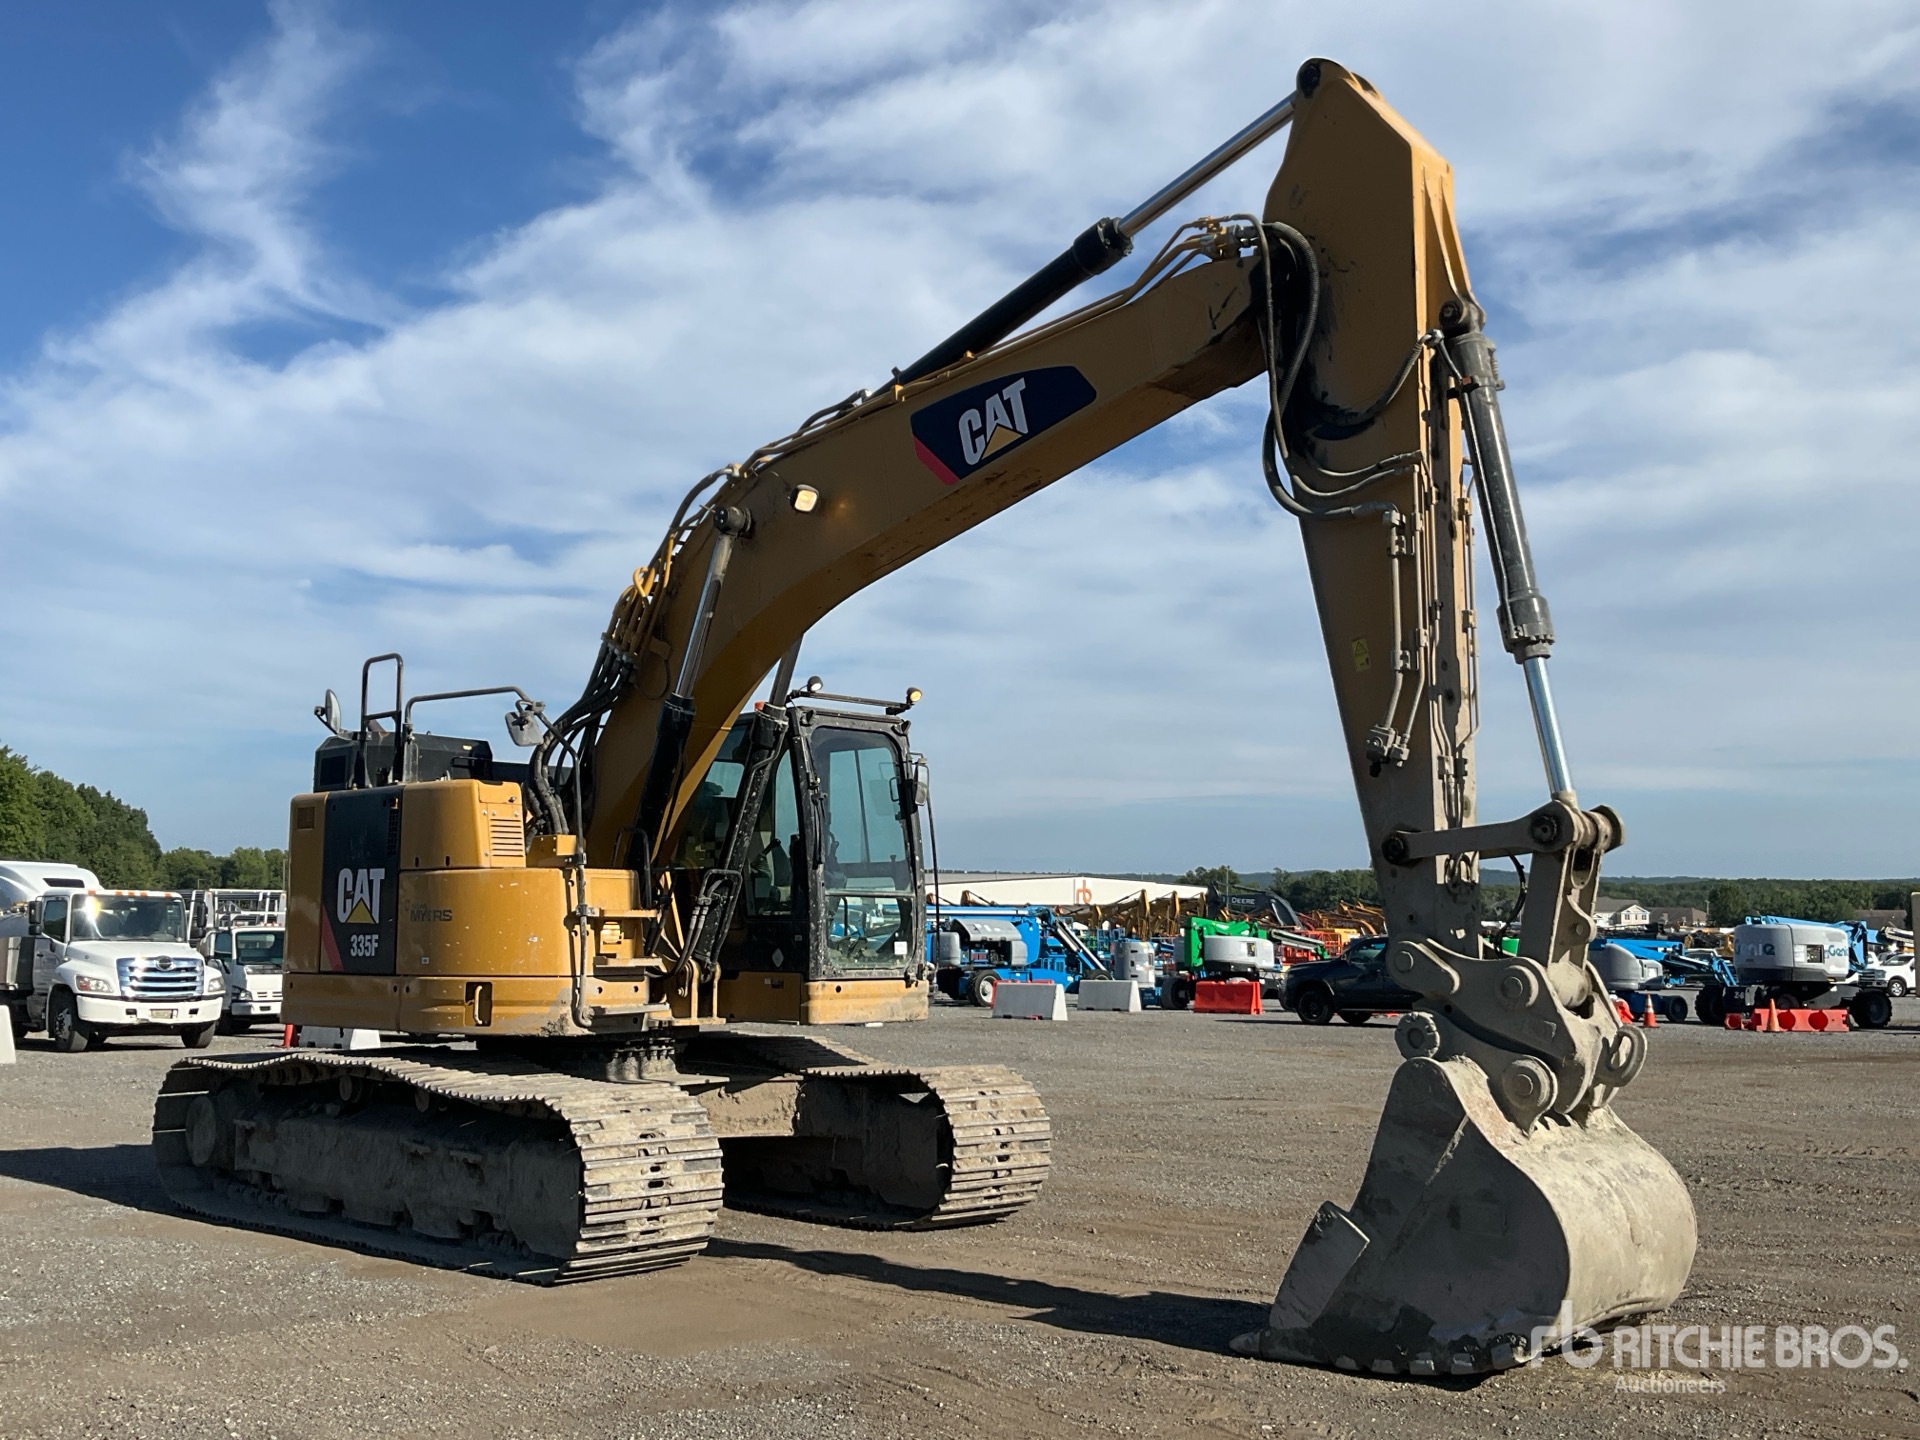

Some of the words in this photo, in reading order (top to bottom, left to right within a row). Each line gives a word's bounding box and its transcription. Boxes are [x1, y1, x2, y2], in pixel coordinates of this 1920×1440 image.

[958, 377, 1029, 466] CAT
[337, 868, 385, 924] CAT
[1231, 896, 1256, 905] DEERE
[350, 934, 379, 957] 335F
[1827, 944, 1849, 956] Geni
